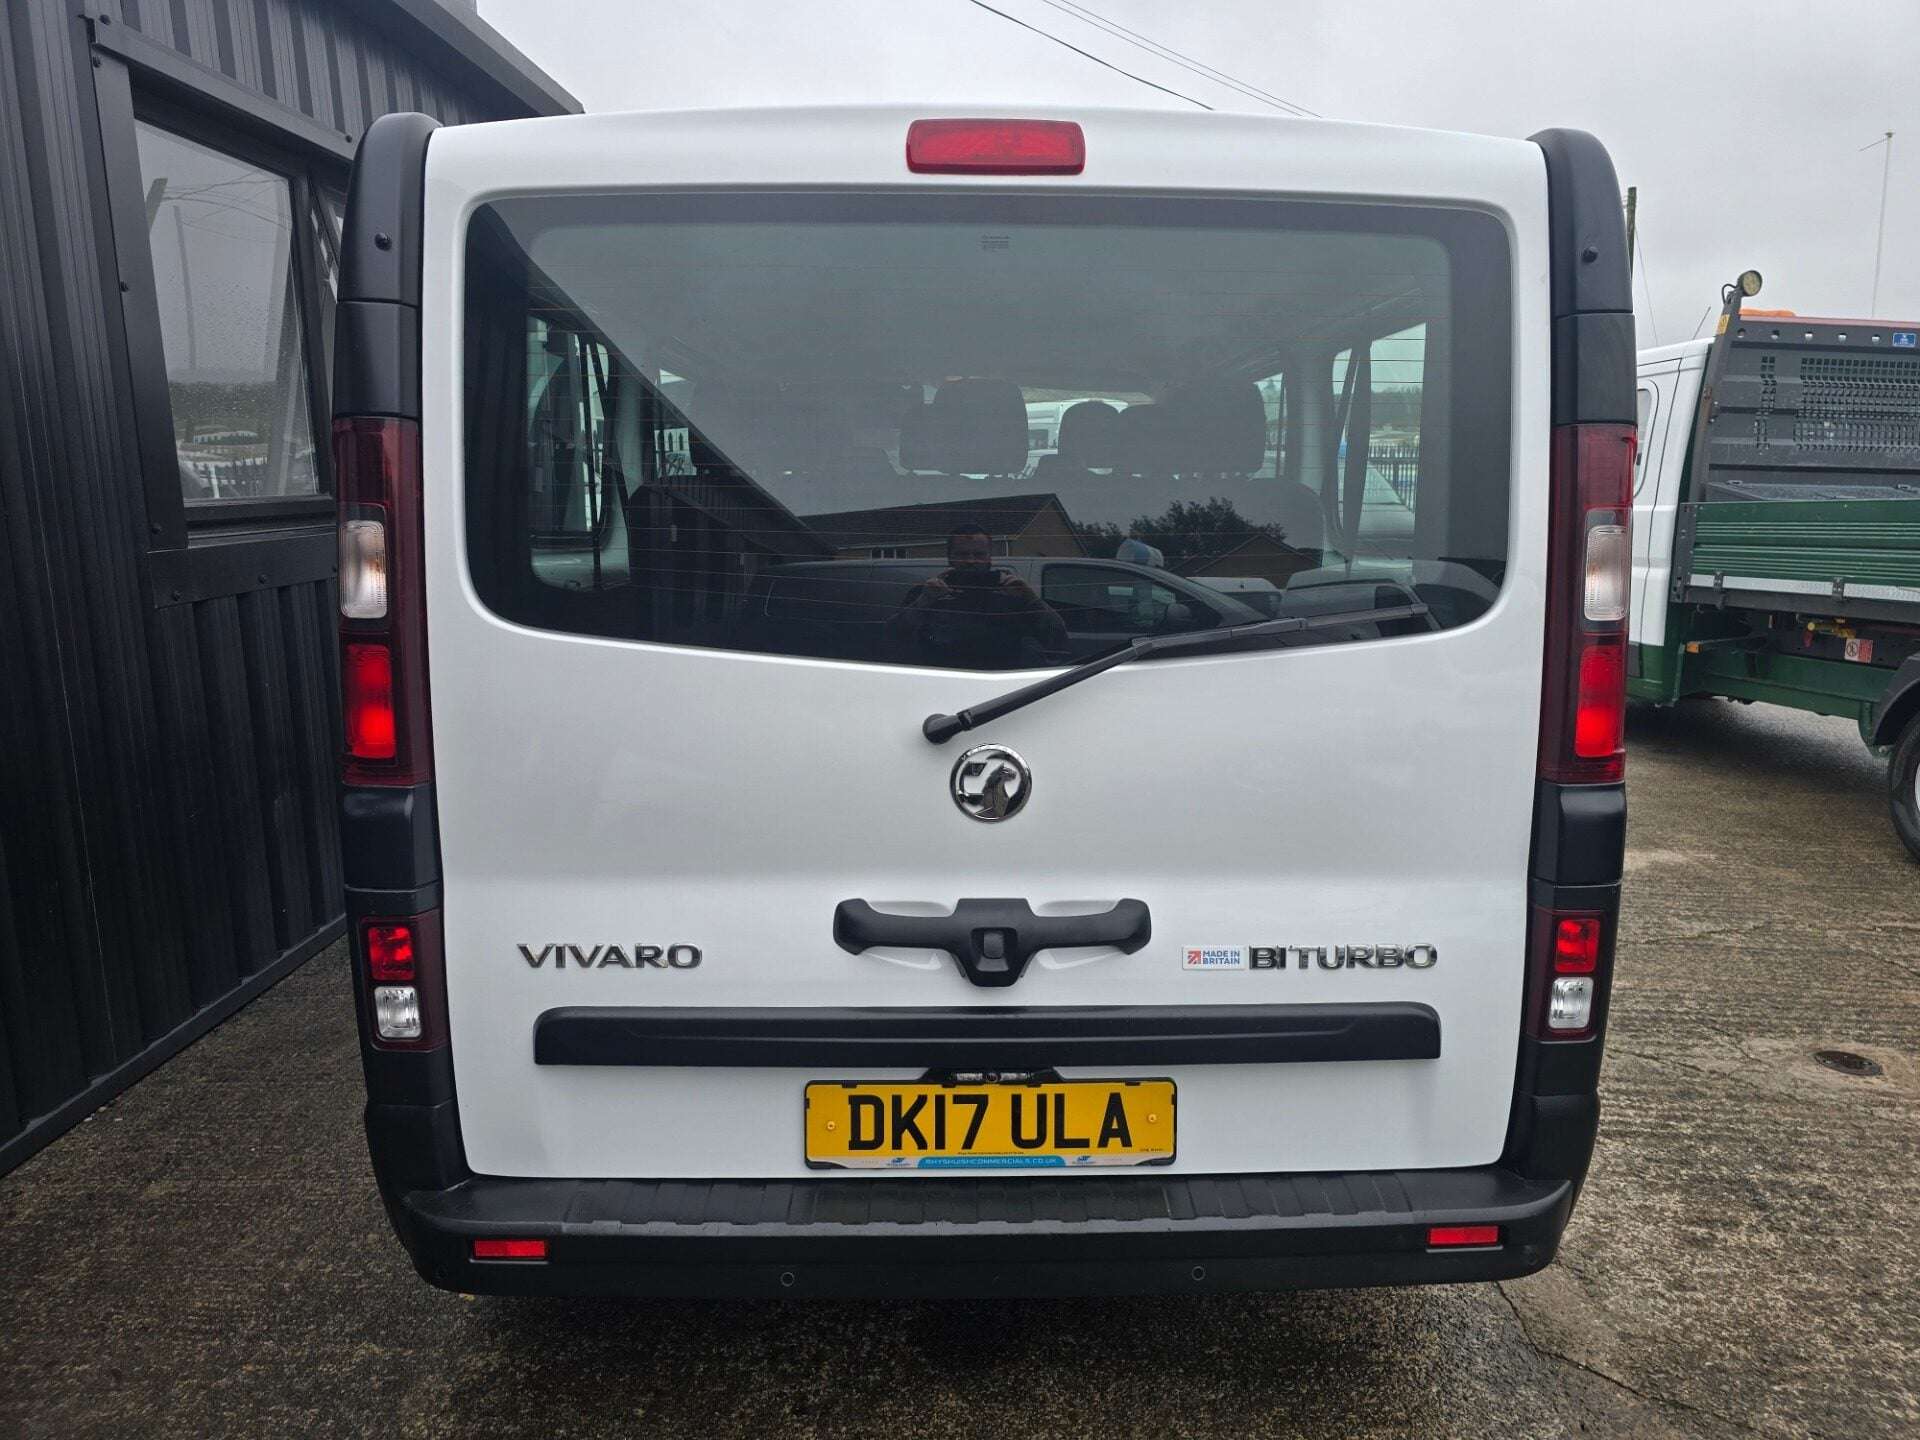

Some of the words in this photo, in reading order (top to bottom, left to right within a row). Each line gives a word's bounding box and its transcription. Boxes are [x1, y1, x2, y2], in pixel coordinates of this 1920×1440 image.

[517, 943, 703, 969] VIVARO
[1249, 943, 1438, 970] BITURBO
[848, 1094, 990, 1151] DK17
[1010, 1092, 1133, 1149] ULA
